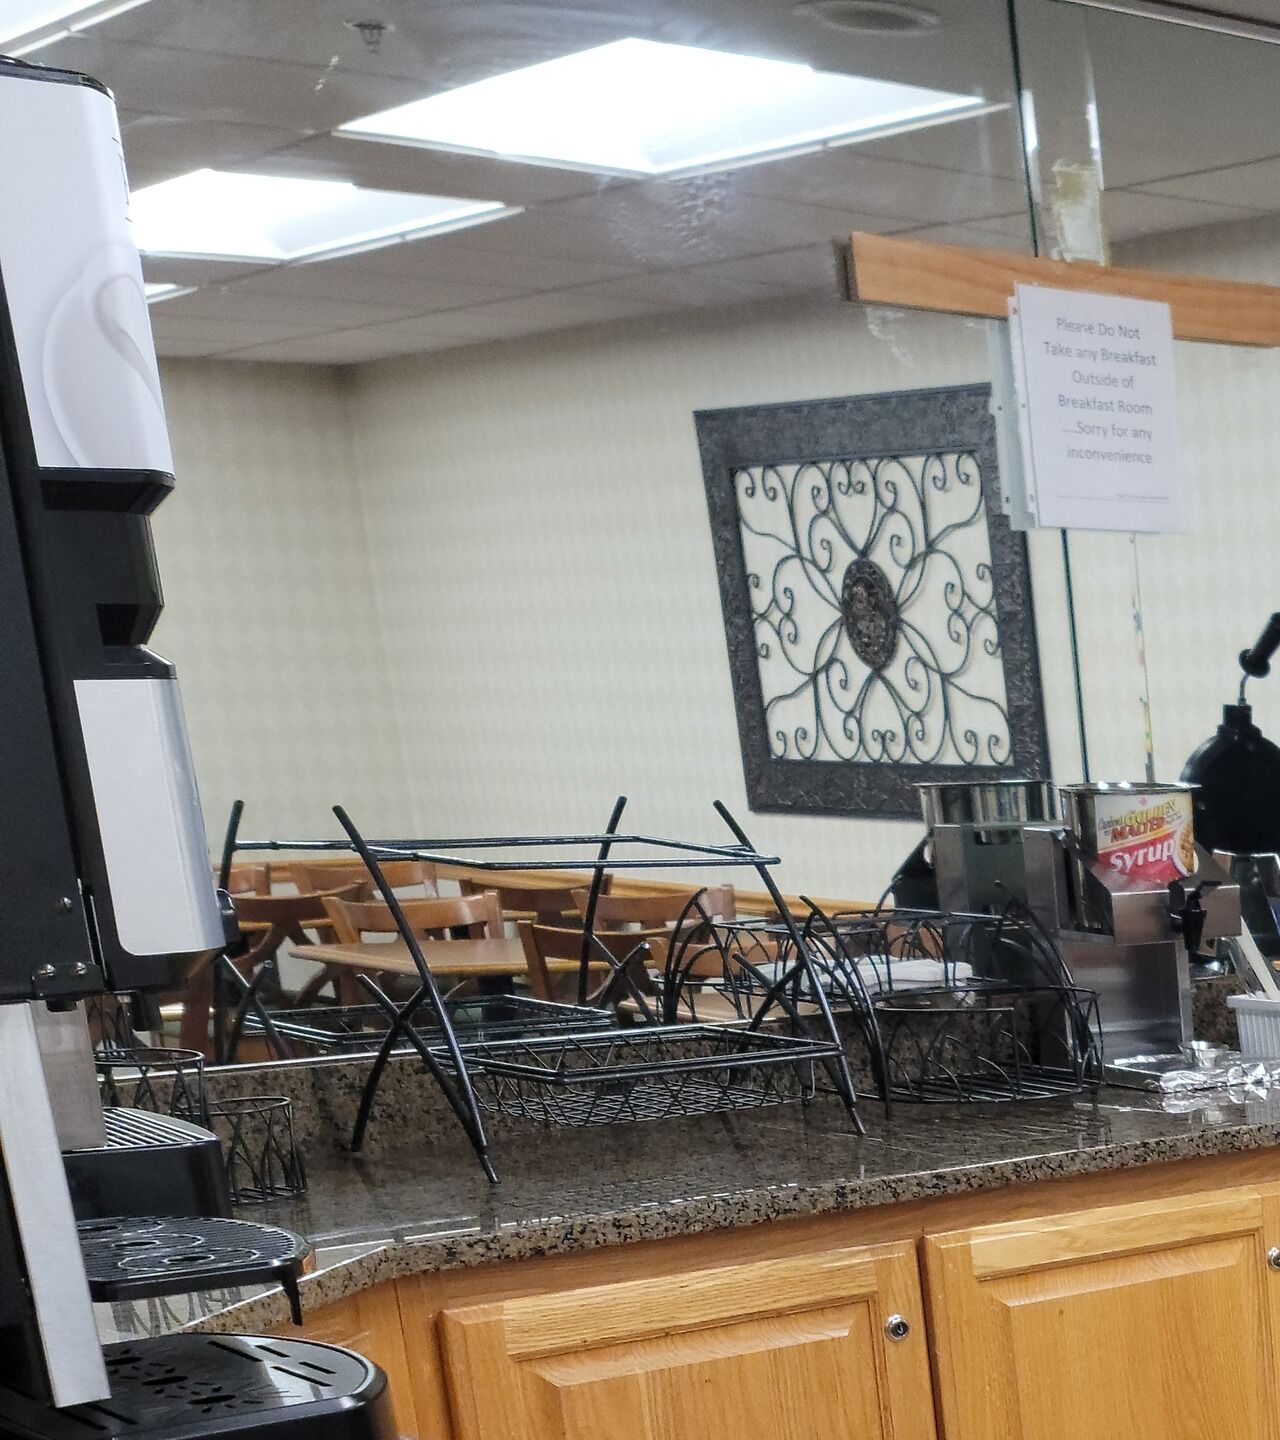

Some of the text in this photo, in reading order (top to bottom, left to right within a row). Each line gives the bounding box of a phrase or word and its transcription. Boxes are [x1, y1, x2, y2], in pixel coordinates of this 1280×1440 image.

[1056, 317, 1140, 340] Please Do Not
[1043, 340, 1157, 367] Take any Breakfast
[1072, 370, 1134, 389] Outside of
[1058, 394, 1153, 415] Breakfast Room
[1111, 423, 1128, 438] for
[1132, 428, 1153, 443] any
[1067, 447, 1152, 464] inconvenience
